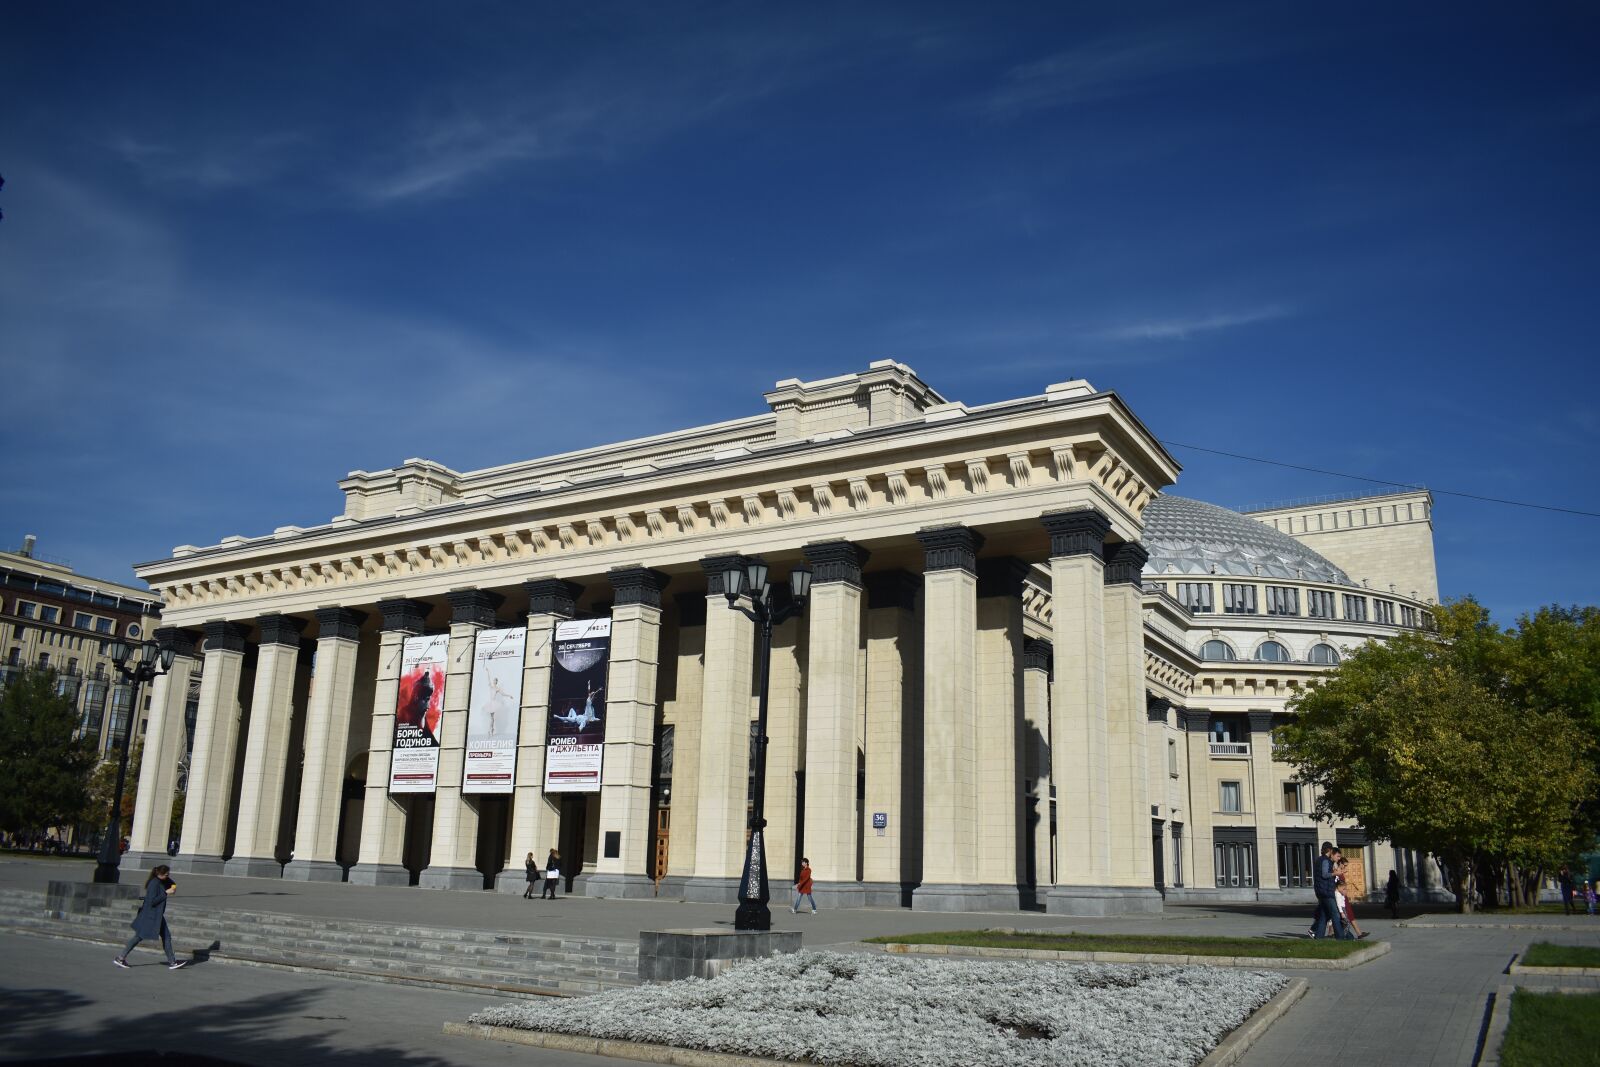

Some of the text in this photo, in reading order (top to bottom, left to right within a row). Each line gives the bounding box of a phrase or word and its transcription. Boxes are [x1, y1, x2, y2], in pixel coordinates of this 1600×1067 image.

[397, 729, 424, 738] БОРИС
[396, 738, 432, 748] ГОДУНОВ
[469, 740, 514, 750] КОППЕЛИЯ
[550, 737, 577, 745] РОМЕО
[556, 745, 600, 754] ДЖУЛЬЕТТА
